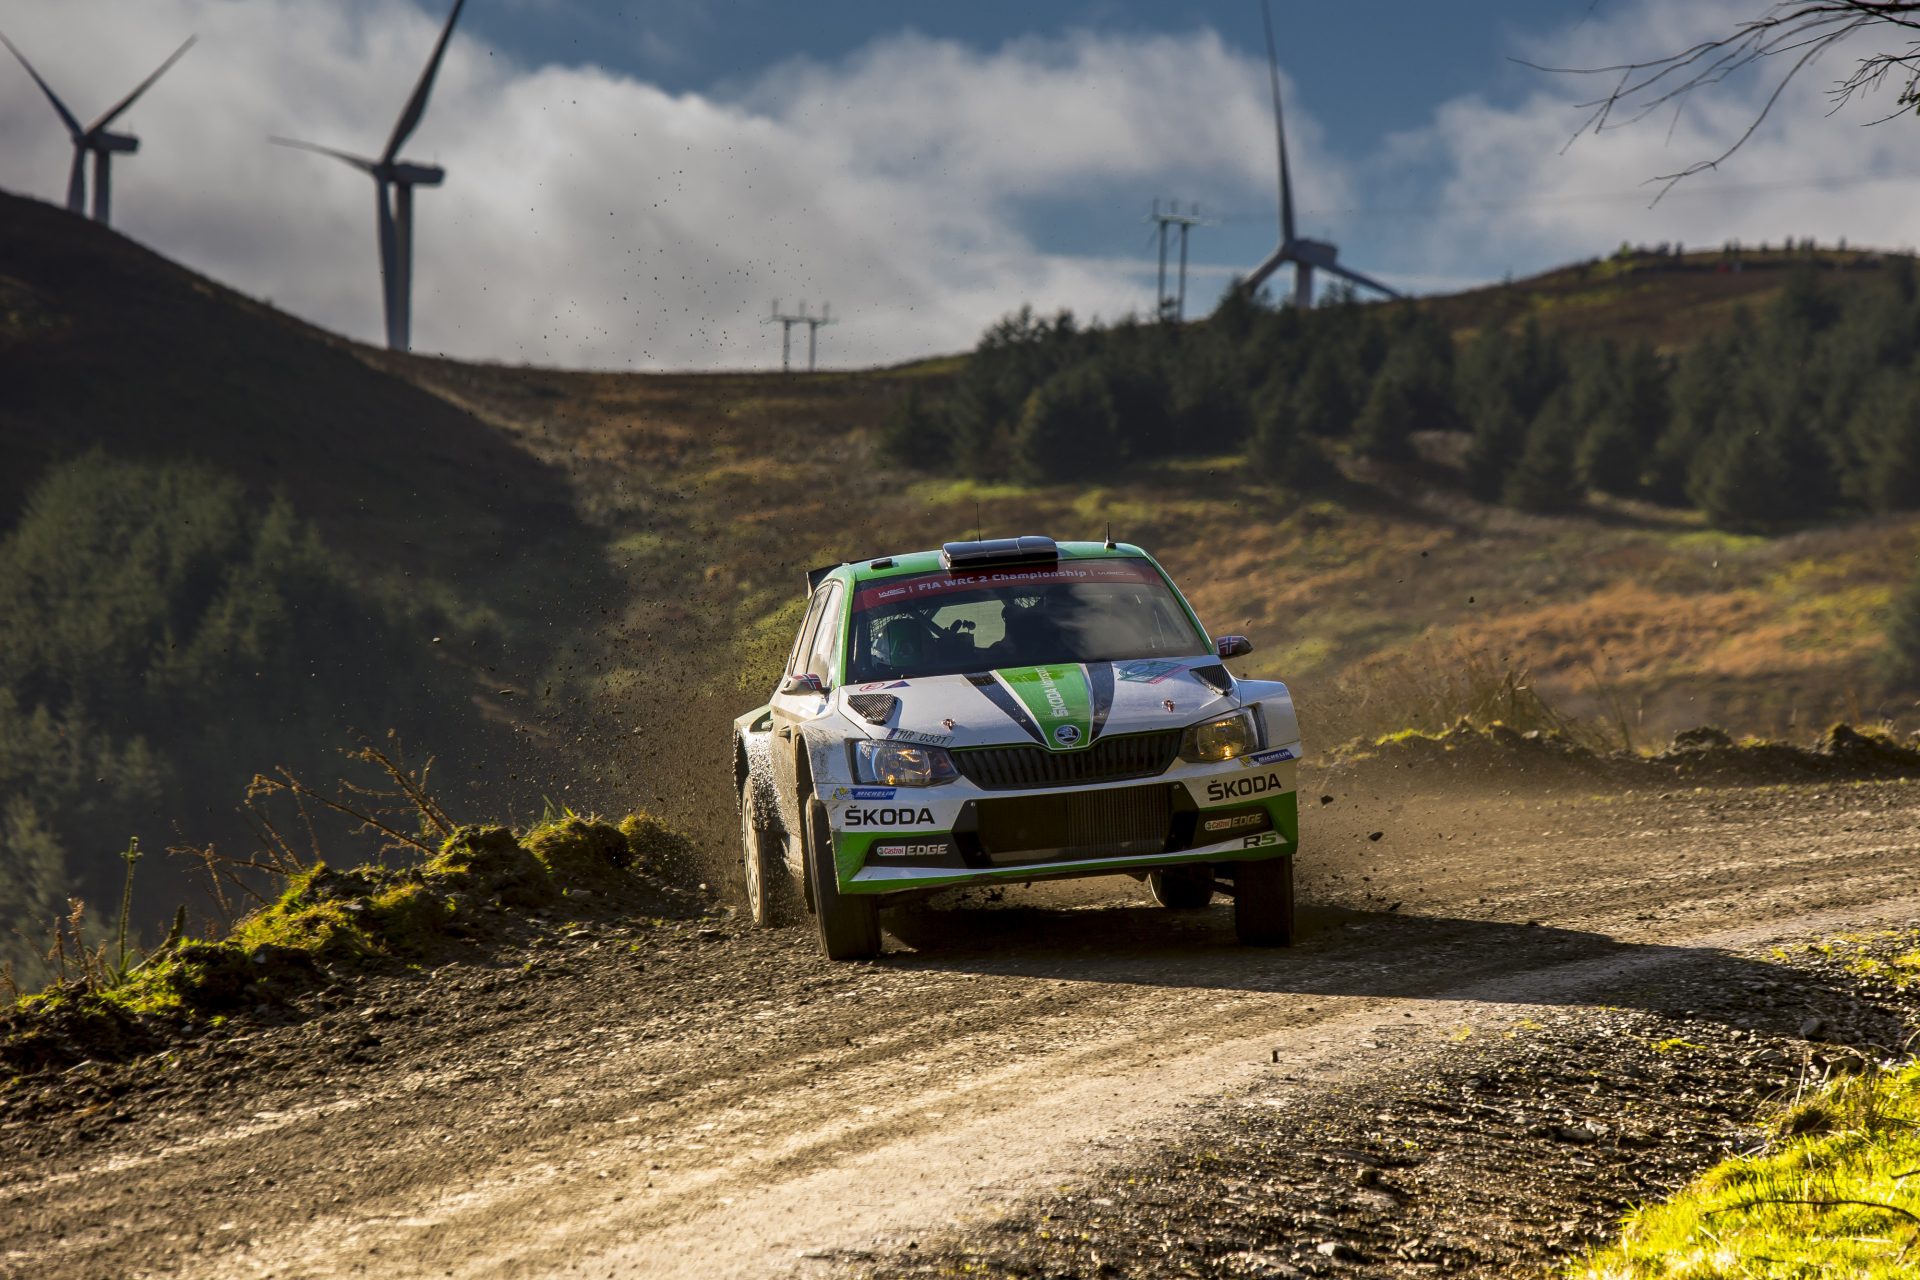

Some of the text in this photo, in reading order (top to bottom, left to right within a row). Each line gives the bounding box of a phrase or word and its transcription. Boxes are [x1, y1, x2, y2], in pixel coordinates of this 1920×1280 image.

[918, 581, 942, 591] FIA
[944, 577, 974, 586] WRC
[979, 575, 988, 583] 2
[991, 568, 1087, 581] Championship
[1047, 687, 1069, 717] ŠKODA
[1258, 751, 1291, 762] MICHELIN
[1207, 774, 1281, 801] ŠKODA
[845, 805, 935, 826] ŠKODA
[1232, 813, 1262, 828] EDGE
[884, 844, 949, 855] Castrol EDGE
[1243, 833, 1277, 848] R5
